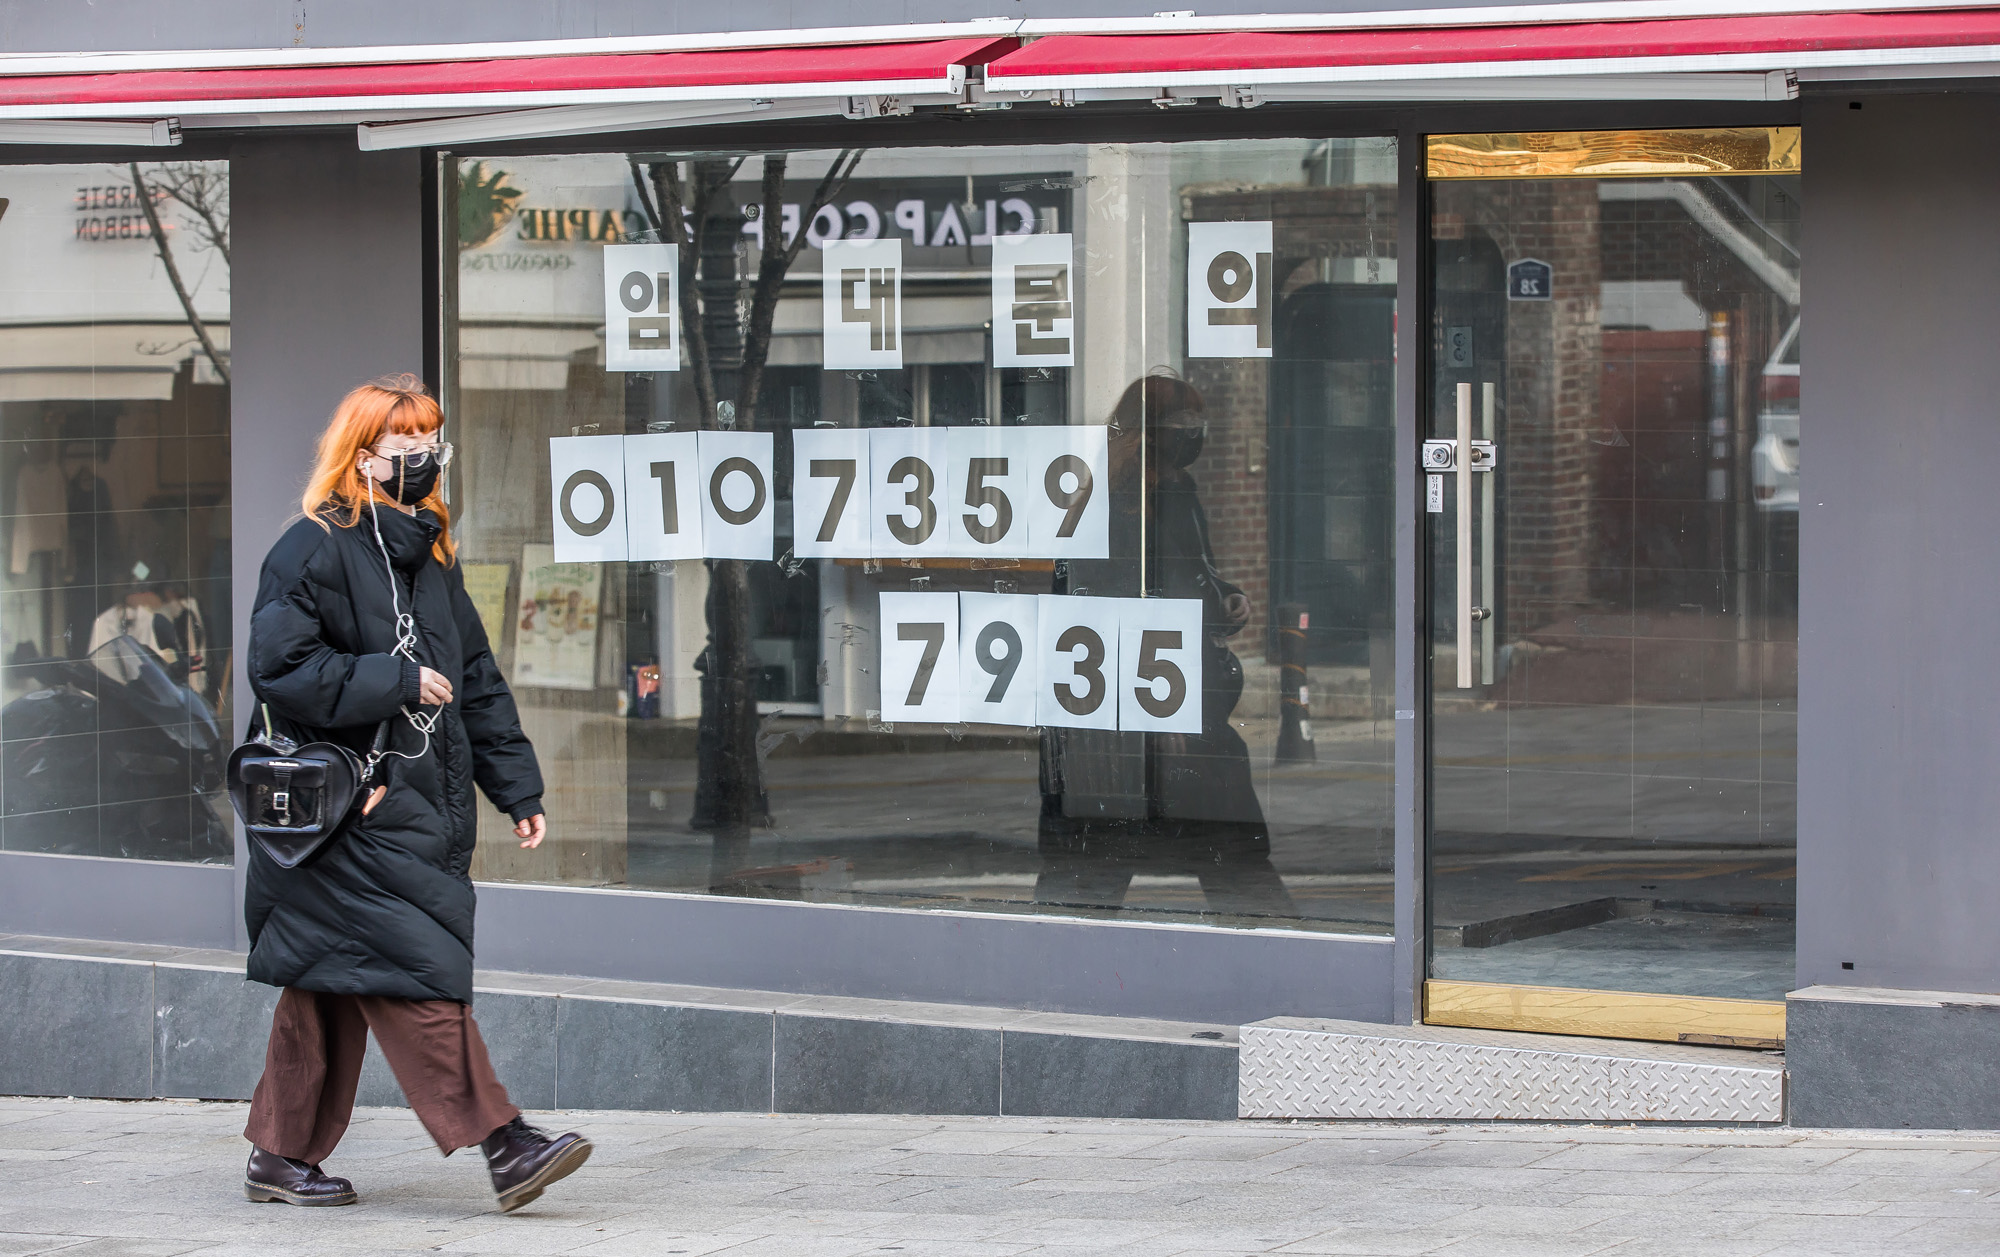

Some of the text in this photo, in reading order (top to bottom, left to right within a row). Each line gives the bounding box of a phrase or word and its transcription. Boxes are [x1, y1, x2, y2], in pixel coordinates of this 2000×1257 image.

[560, 455, 1093, 545] 010 7359
[897, 621, 1186, 718] 7935
